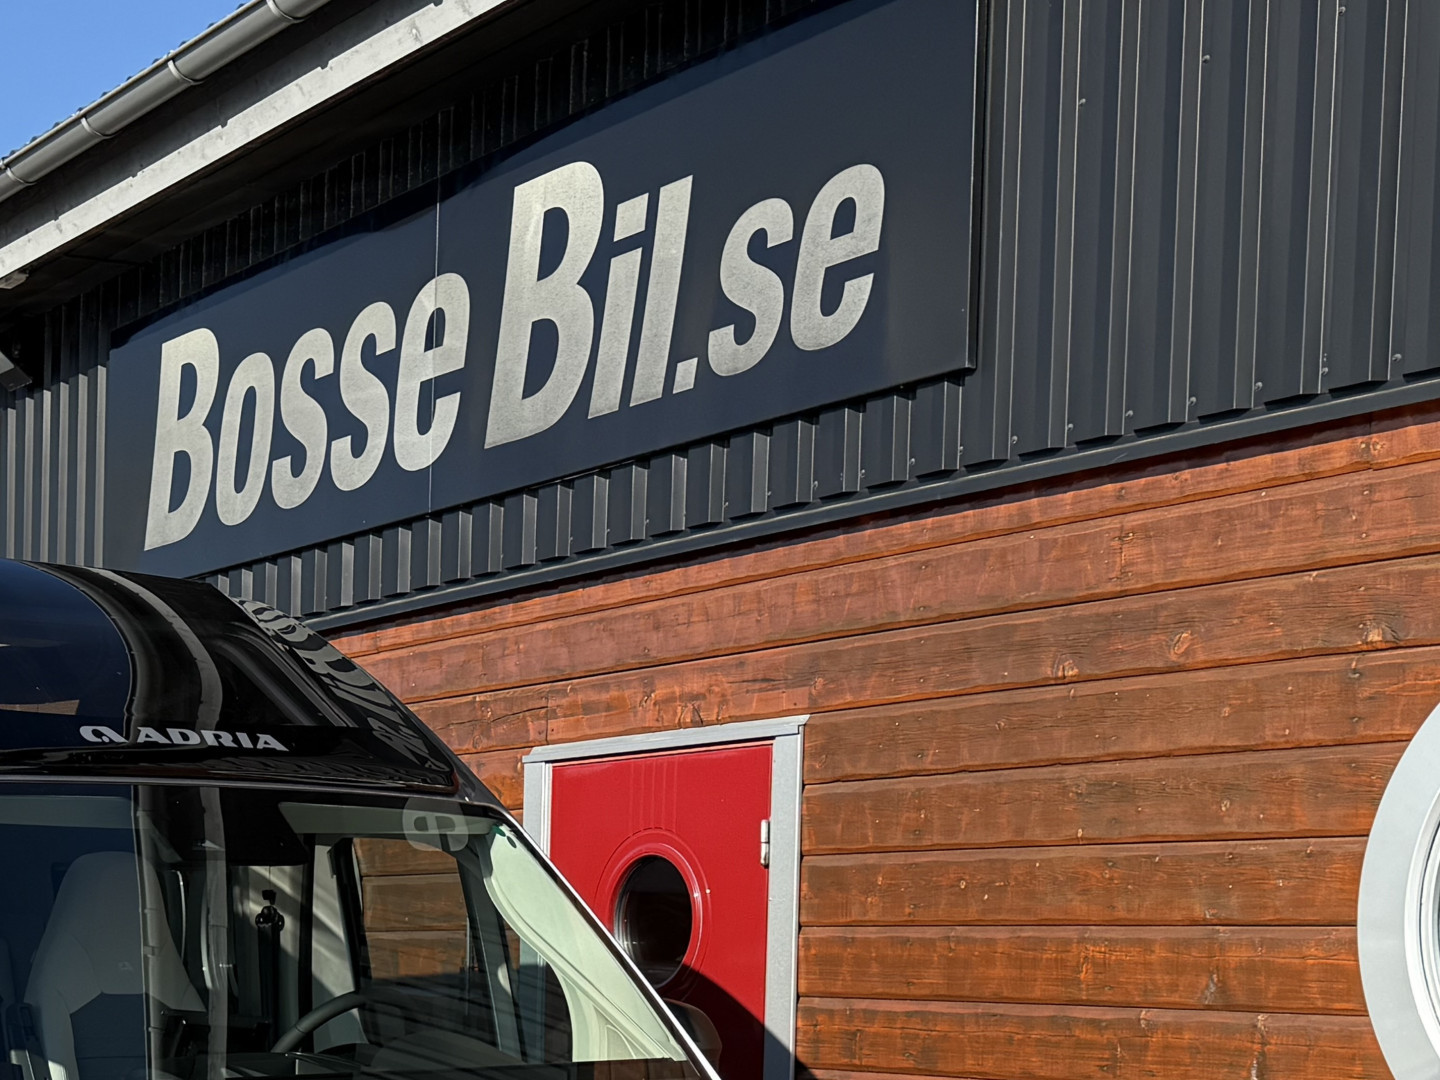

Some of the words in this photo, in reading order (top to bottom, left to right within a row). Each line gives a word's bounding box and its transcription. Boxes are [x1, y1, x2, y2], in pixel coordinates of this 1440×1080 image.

[144, 273, 470, 551] Bosse
[484, 161, 886, 450] Bil.se
[137, 726, 290, 751] ADRIA
